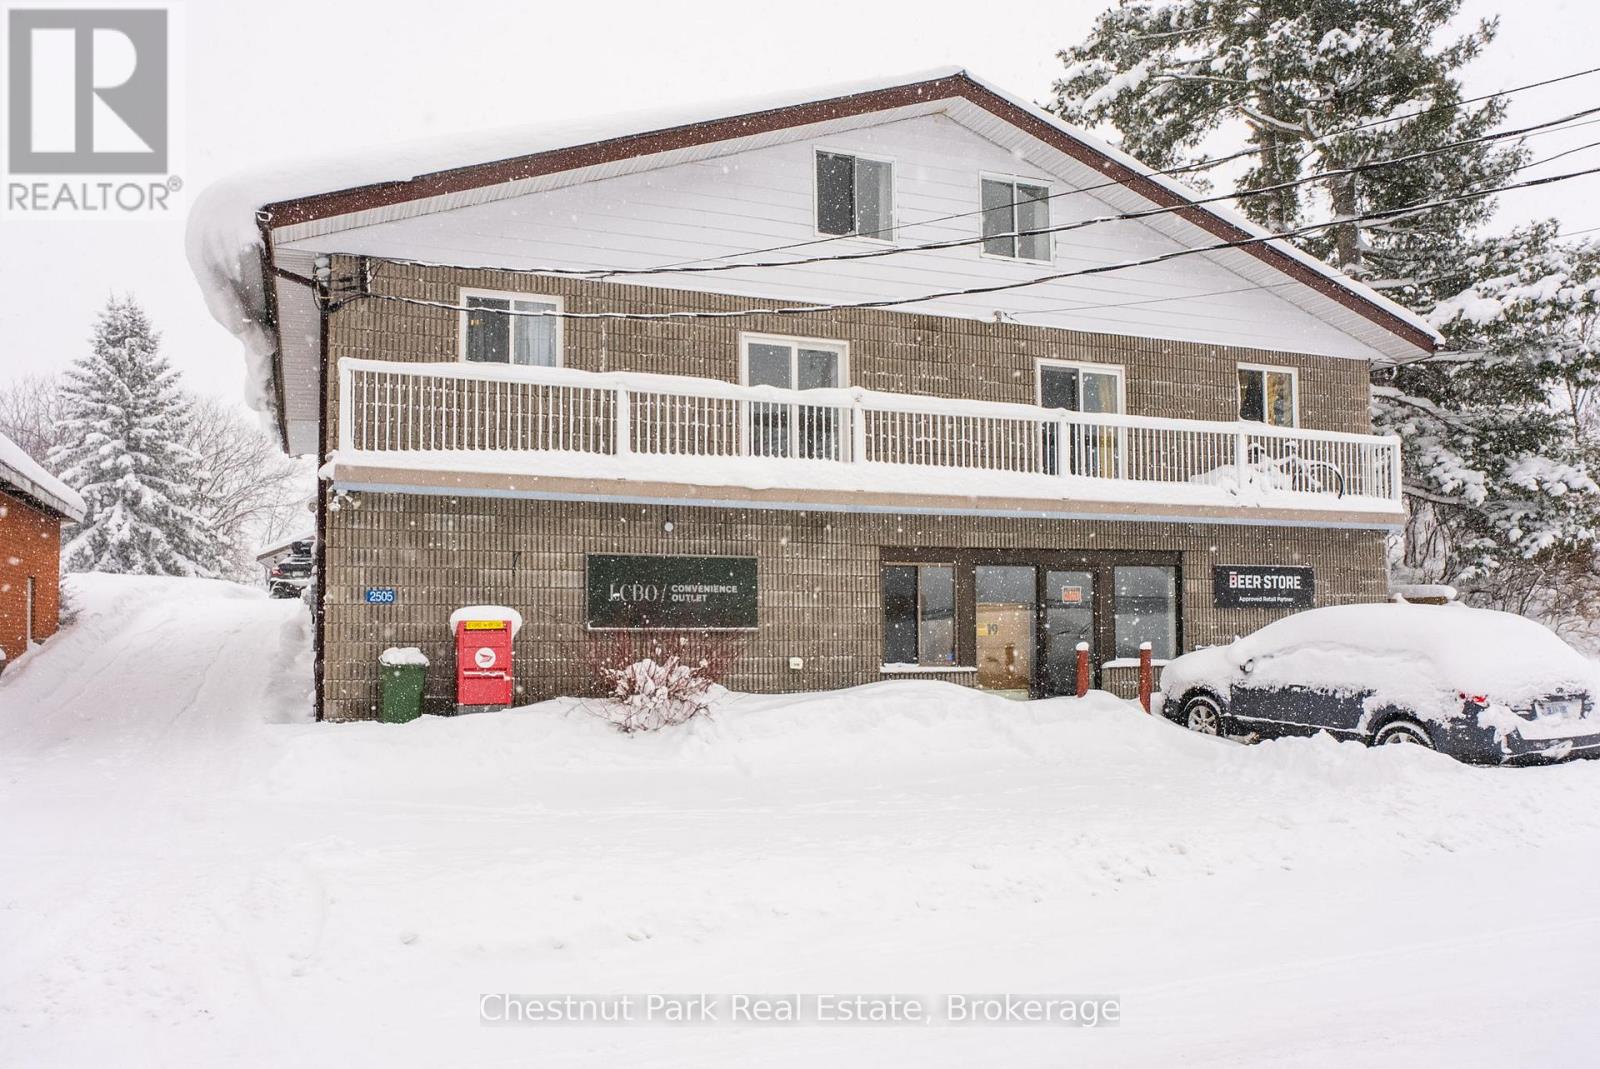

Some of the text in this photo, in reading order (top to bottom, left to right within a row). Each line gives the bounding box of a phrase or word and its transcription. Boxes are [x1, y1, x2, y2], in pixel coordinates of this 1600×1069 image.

[1229, 574, 1301, 590] BEER STORE
[671, 584, 738, 594] CONVENIENCE
[369, 591, 394, 602] 2505
[671, 594, 708, 602] OUTLET
